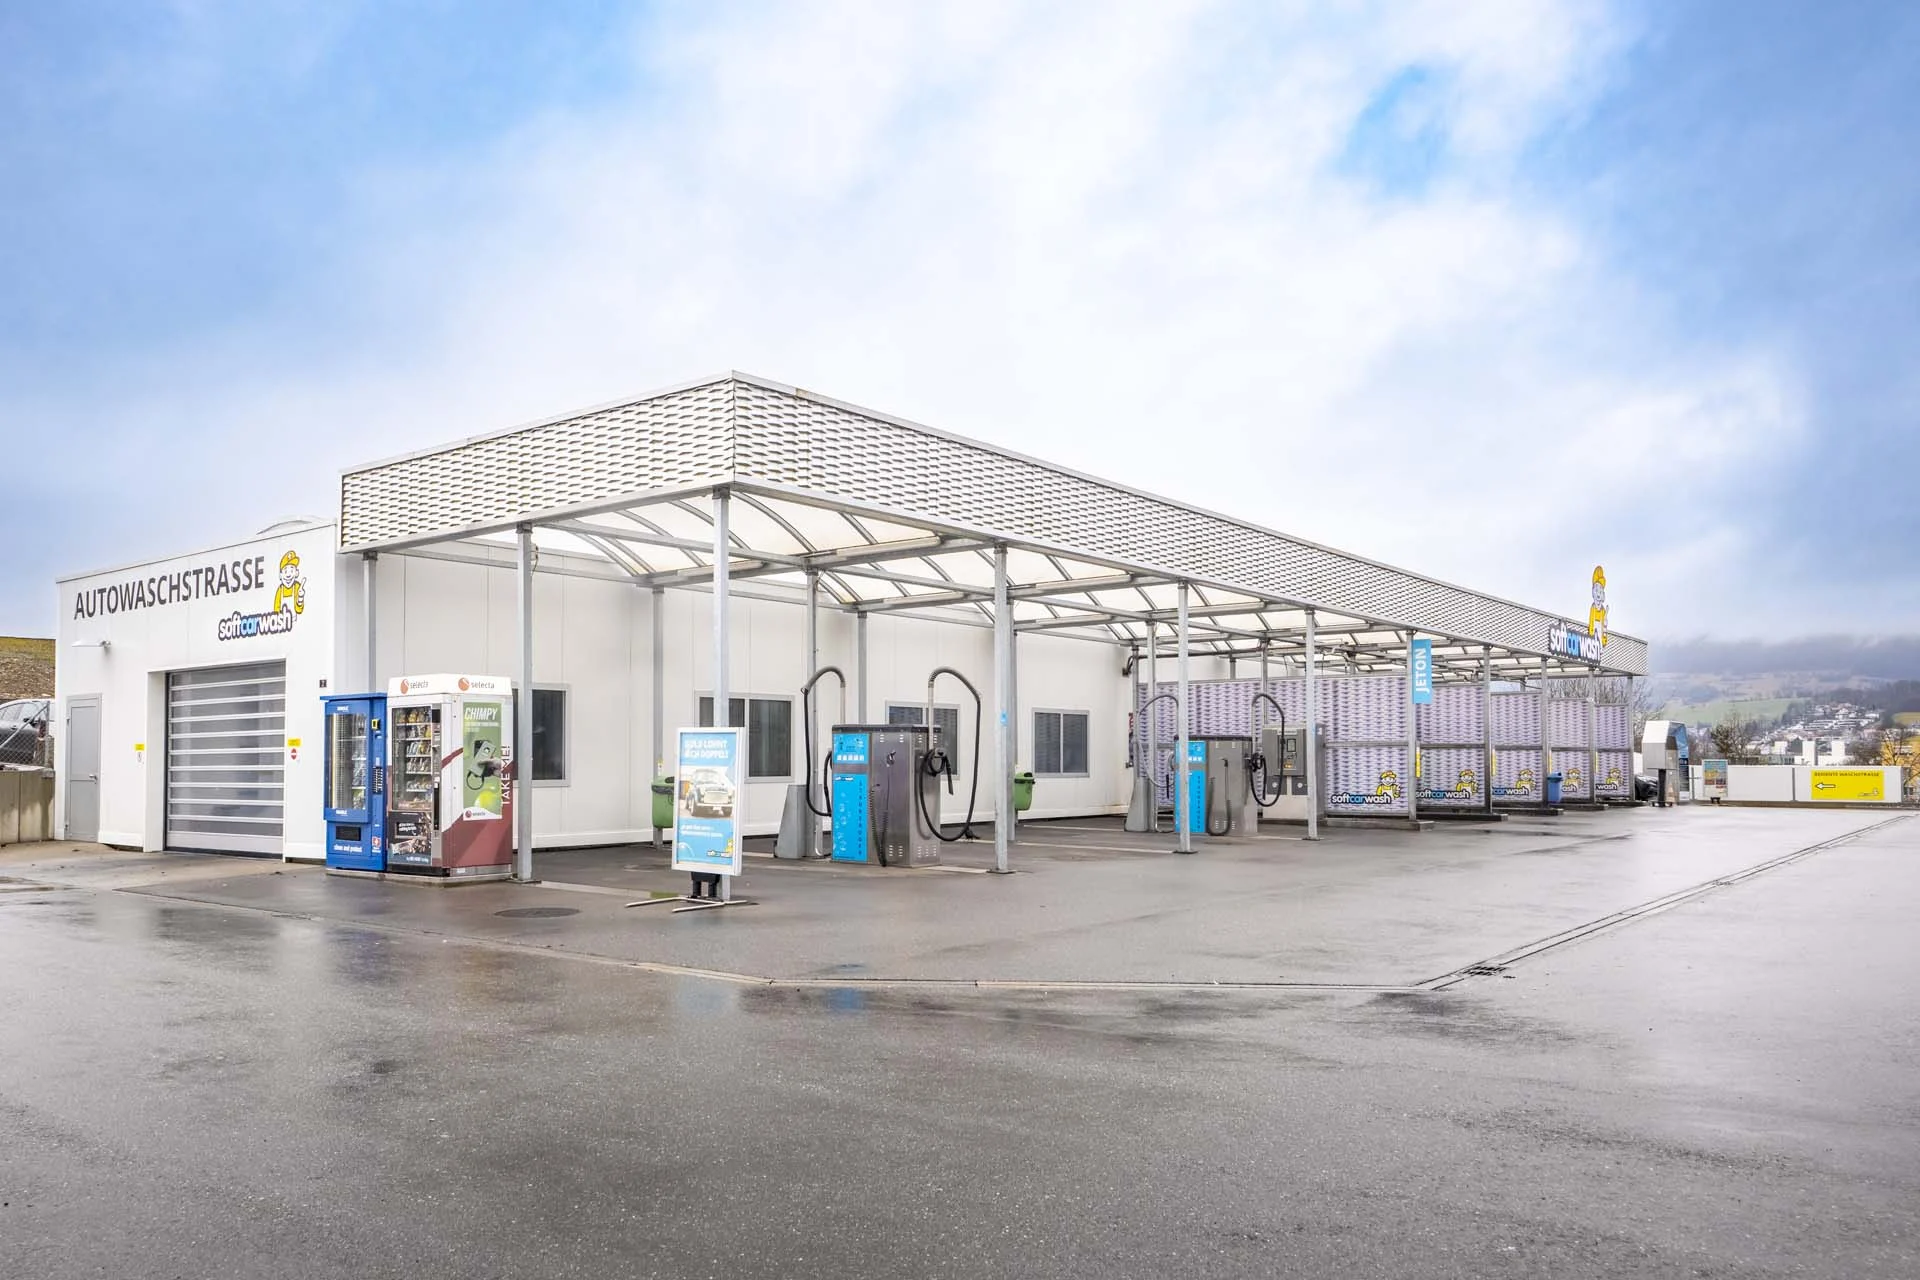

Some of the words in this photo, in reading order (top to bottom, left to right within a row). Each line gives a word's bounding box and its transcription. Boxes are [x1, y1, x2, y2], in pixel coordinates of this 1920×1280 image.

[74, 556, 265, 620] AUTOWASCHSTRASSE
[218, 604, 293, 641] softcarwash
[1549, 622, 1601, 664] softcarwash
[1415, 647, 1430, 694] JETON
[410, 680, 429, 689] selecta
[471, 680, 495, 689] selecta
[464, 707, 498, 720] CHIMPY
[501, 745, 511, 772] ME!
[501, 772, 511, 804] TAKE
[1416, 788, 1471, 800] softcarwash
[1492, 785, 1529, 796] carwash
[1331, 792, 1392, 805] softcarwash
